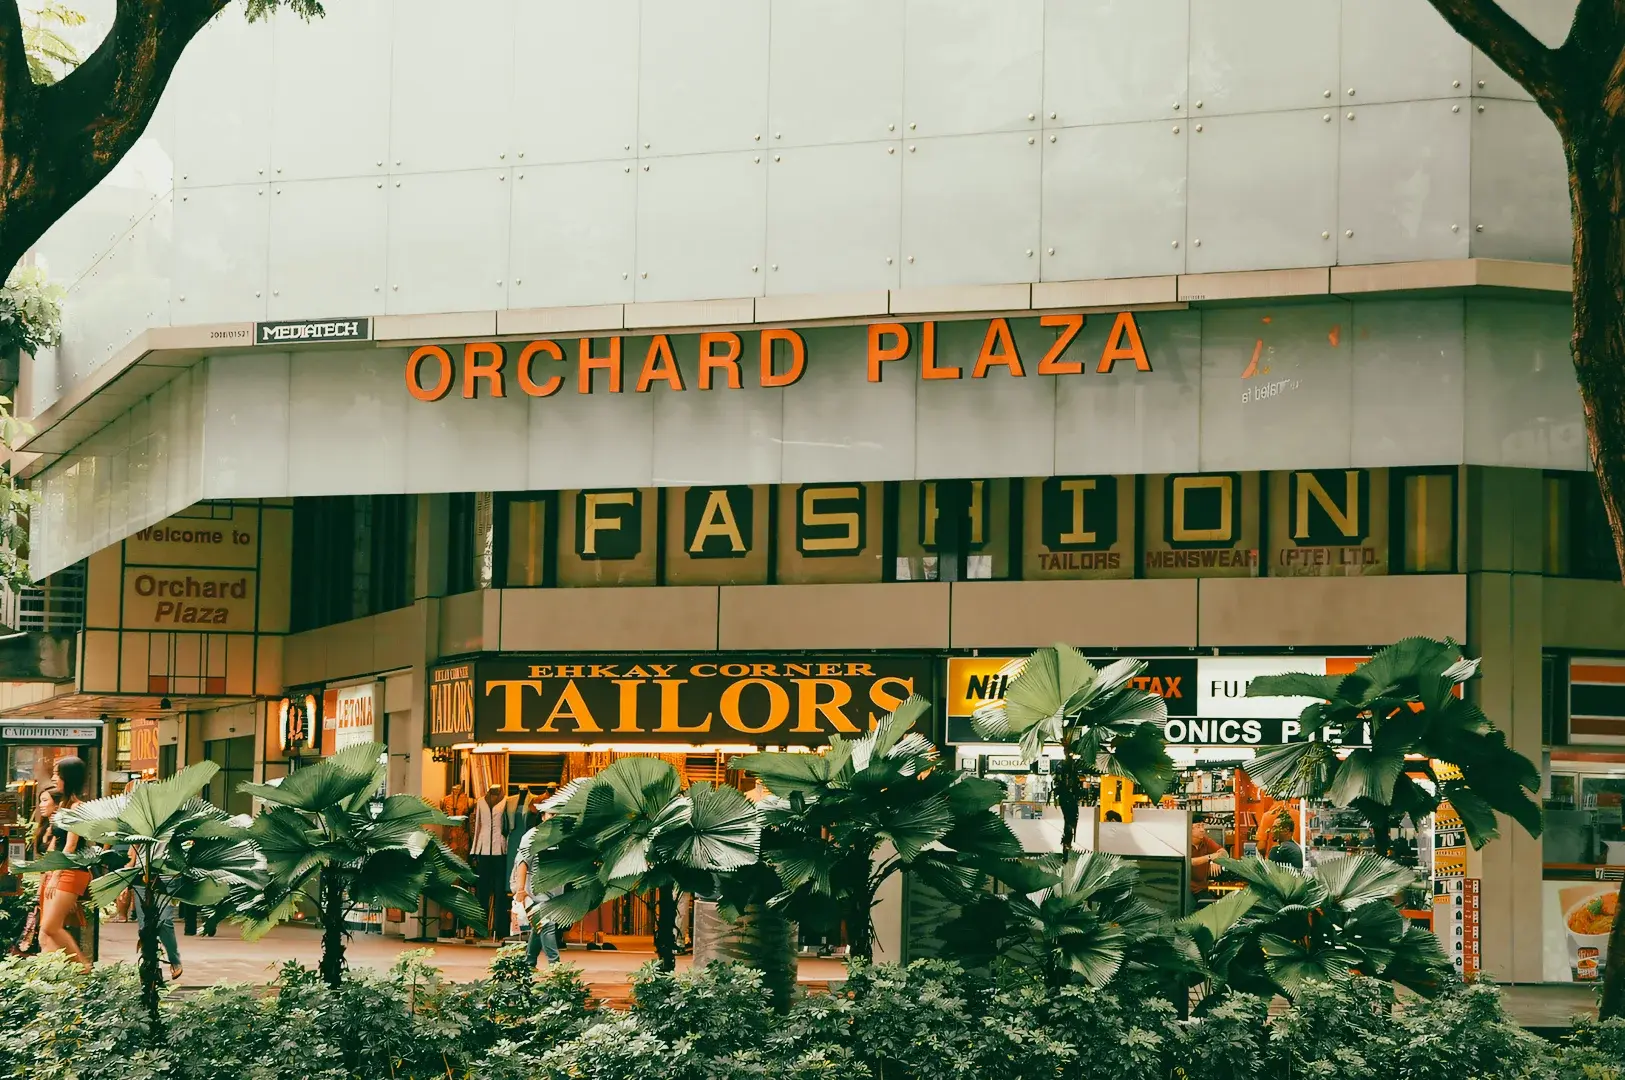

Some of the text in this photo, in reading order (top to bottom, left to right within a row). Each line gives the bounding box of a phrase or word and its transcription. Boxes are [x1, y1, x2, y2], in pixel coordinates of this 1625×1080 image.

[262, 321, 359, 340] MEDIATECH
[405, 312, 1153, 402] ORCHARD PLAZA
[583, 471, 1359, 554] FASHION
[136, 526, 250, 545] Welcome to
[1038, 547, 1380, 571] TAILORS MENSWEAR (PTE) LTD.
[134, 574, 246, 599] Orchard
[154, 601, 229, 624] Plaza
[528, 663, 876, 678] EHKAY CORNER
[431, 679, 474, 734] TAILORS
[485, 676, 915, 734] TAILORS
[1164, 720, 1262, 744] ONICS
